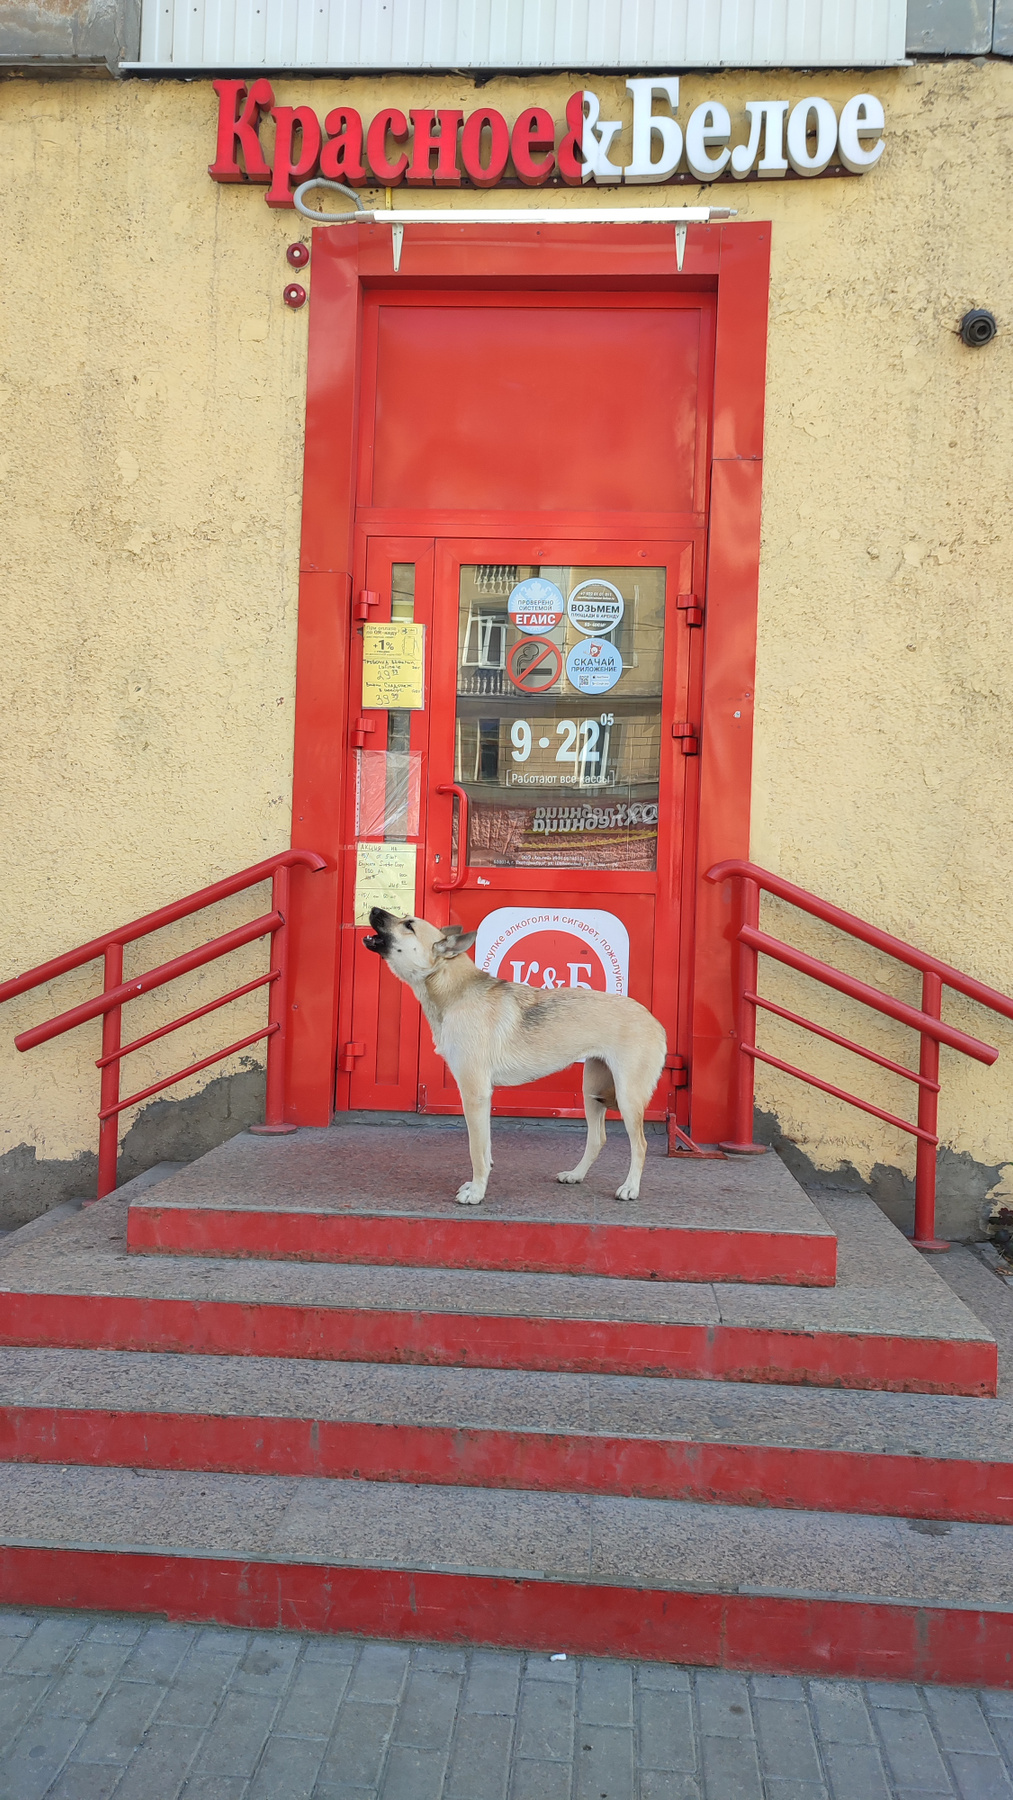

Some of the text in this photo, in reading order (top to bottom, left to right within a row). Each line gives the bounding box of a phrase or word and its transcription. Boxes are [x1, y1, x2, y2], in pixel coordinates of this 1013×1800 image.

[570, 604, 620, 613] ВОЗЬМЕМ
[515, 614, 556, 625] ЕГАИС
[373, 639, 395, 651] +1%
[573, 656, 615, 667] СКАЧАЙ
[600, 713, 615, 726] 05
[560, 775, 577, 784] все
[505, 914, 550, 937] алкоголя
[561, 915, 601, 942] сигарет,
[599, 938, 625, 998] пожалуйст
